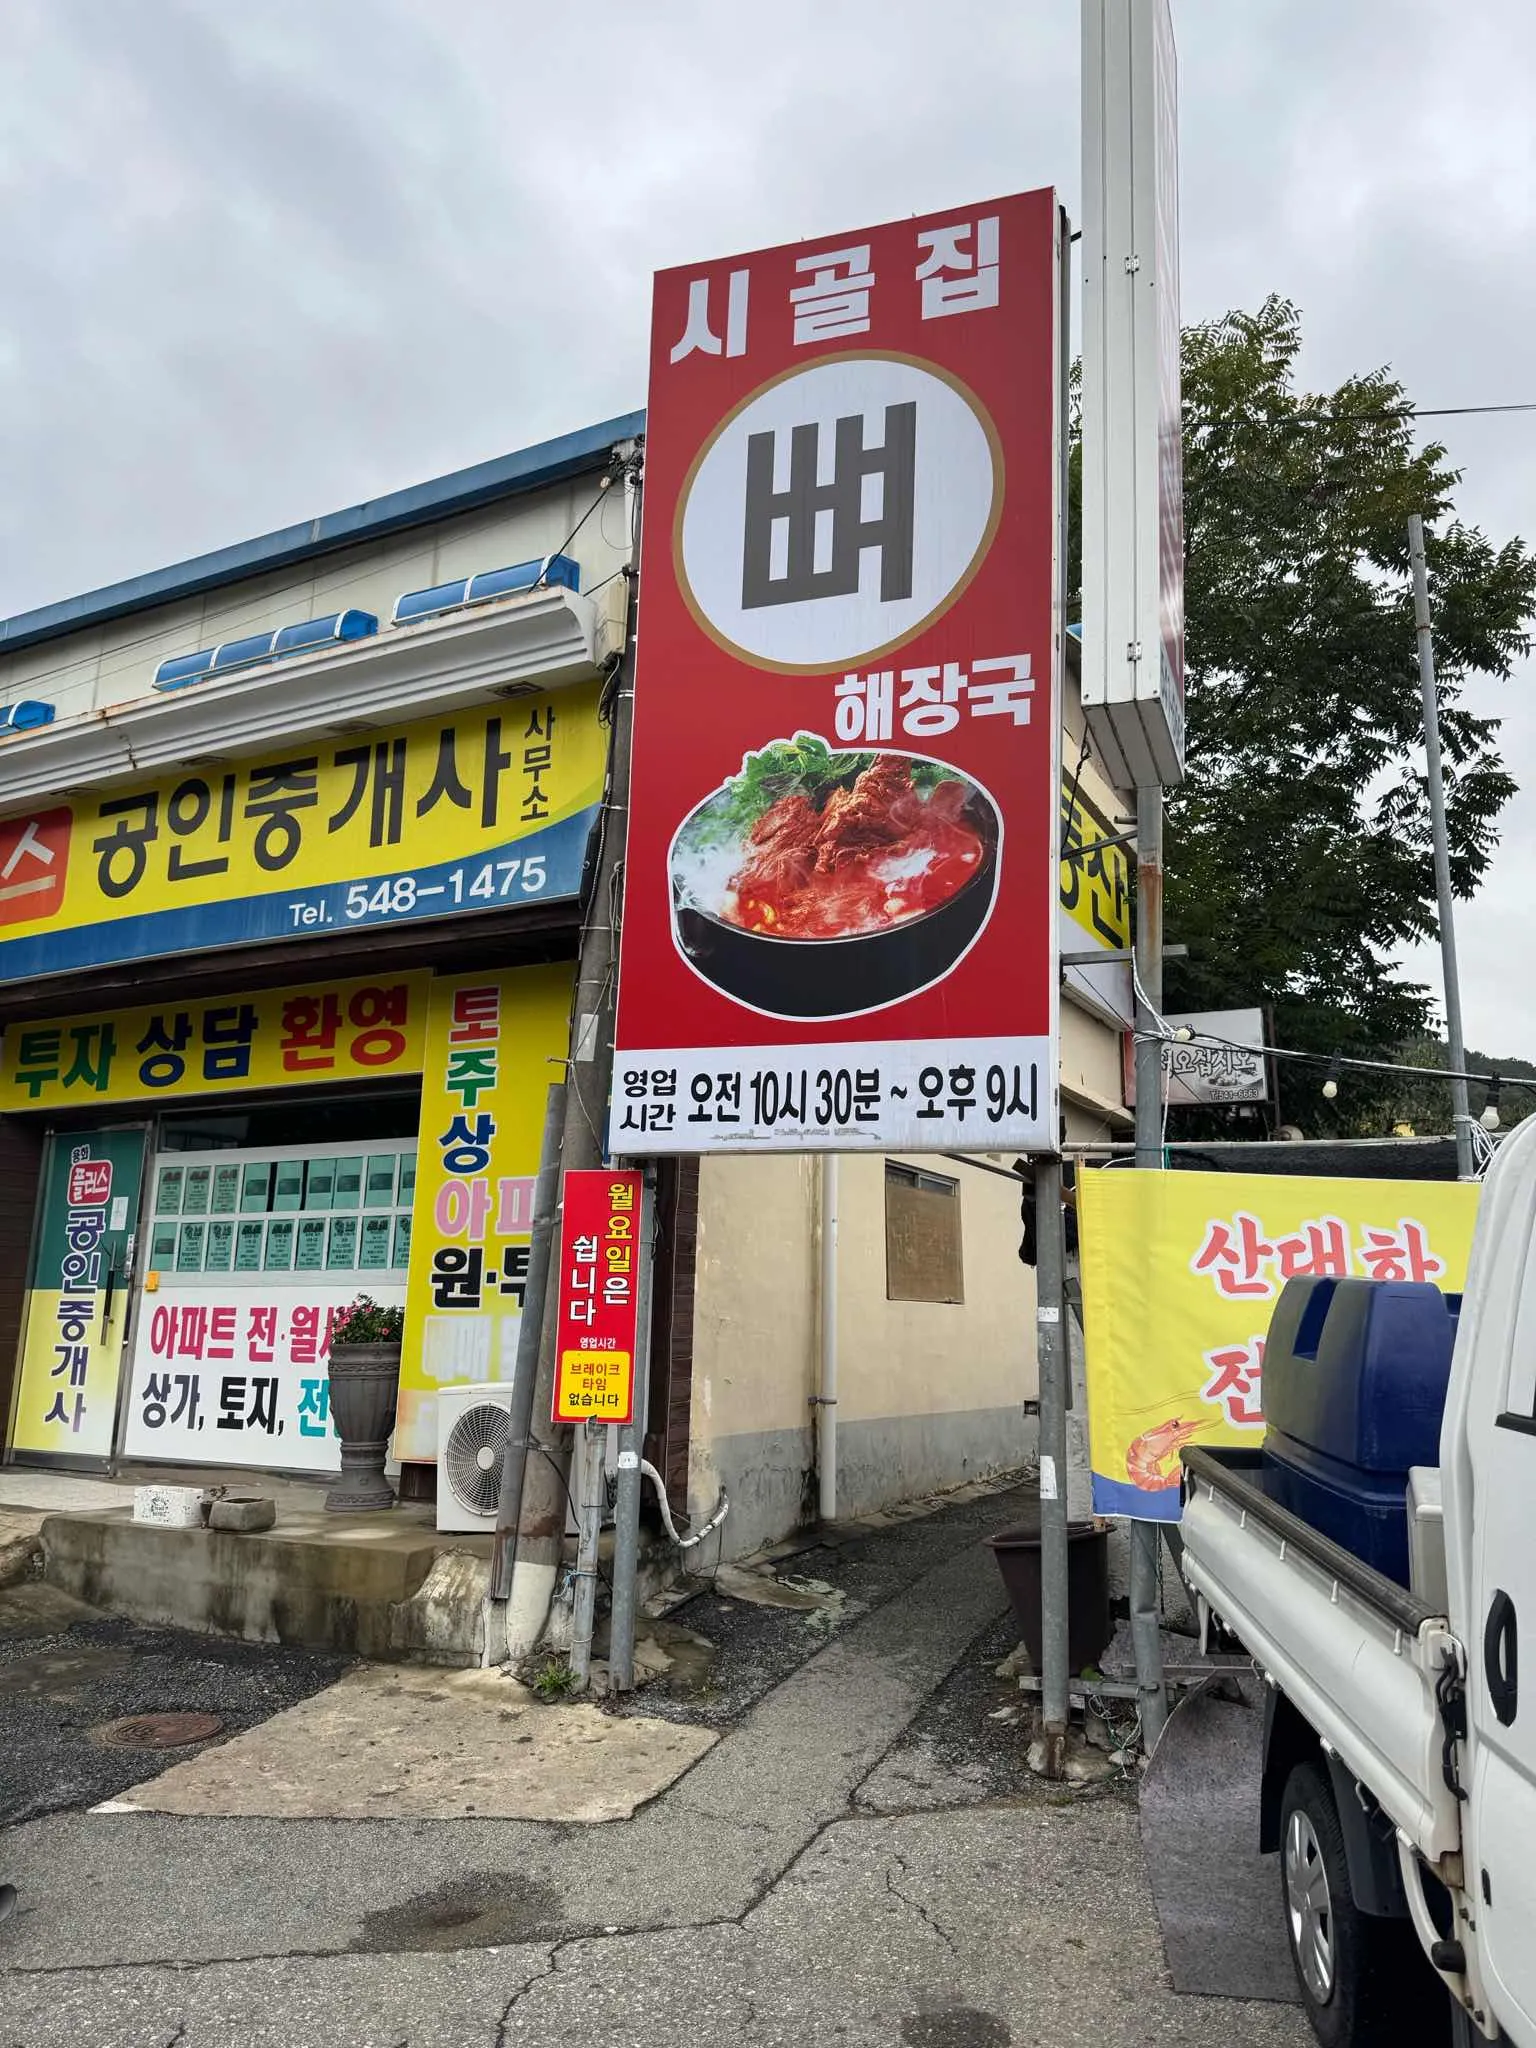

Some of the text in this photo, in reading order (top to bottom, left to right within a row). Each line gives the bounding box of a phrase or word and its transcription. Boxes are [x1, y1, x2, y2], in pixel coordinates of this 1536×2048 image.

[670, 216, 1000, 365] 시골집
[741, 401, 916, 610] 뼈
[834, 653, 1035, 741] 해장국
[521, 705, 556, 821] 사무소
[93, 718, 511, 899] 공인중개사
[0, 821, 56, 900] 스
[289, 855, 546, 927] Tel. 548-1475
[15, 984, 409, 1098] 투자 상담 환영
[619, 1103, 677, 1132] 시간
[623, 1069, 677, 1098] 영업
[688, 1072, 741, 1123] 오전
[916, 1064, 977, 1121] 오후
[986, 1063, 1038, 1122] 9시
[71, 1166, 109, 1201] 플러스
[602, 1183, 633, 1305] 월요일은
[569, 1235, 599, 1326] 쉽니다
[43, 1208, 106, 1433] 공인중개사
[151, 1305, 238, 1361] 아파트
[579, 1337, 616, 1349] 영업시간
[568, 1393, 619, 1407] 없습니다
[570, 1363, 620, 1376] 브레이크
[582, 1378, 607, 1391] 타임
[142, 1373, 341, 1439] 상가, 토지, 전
